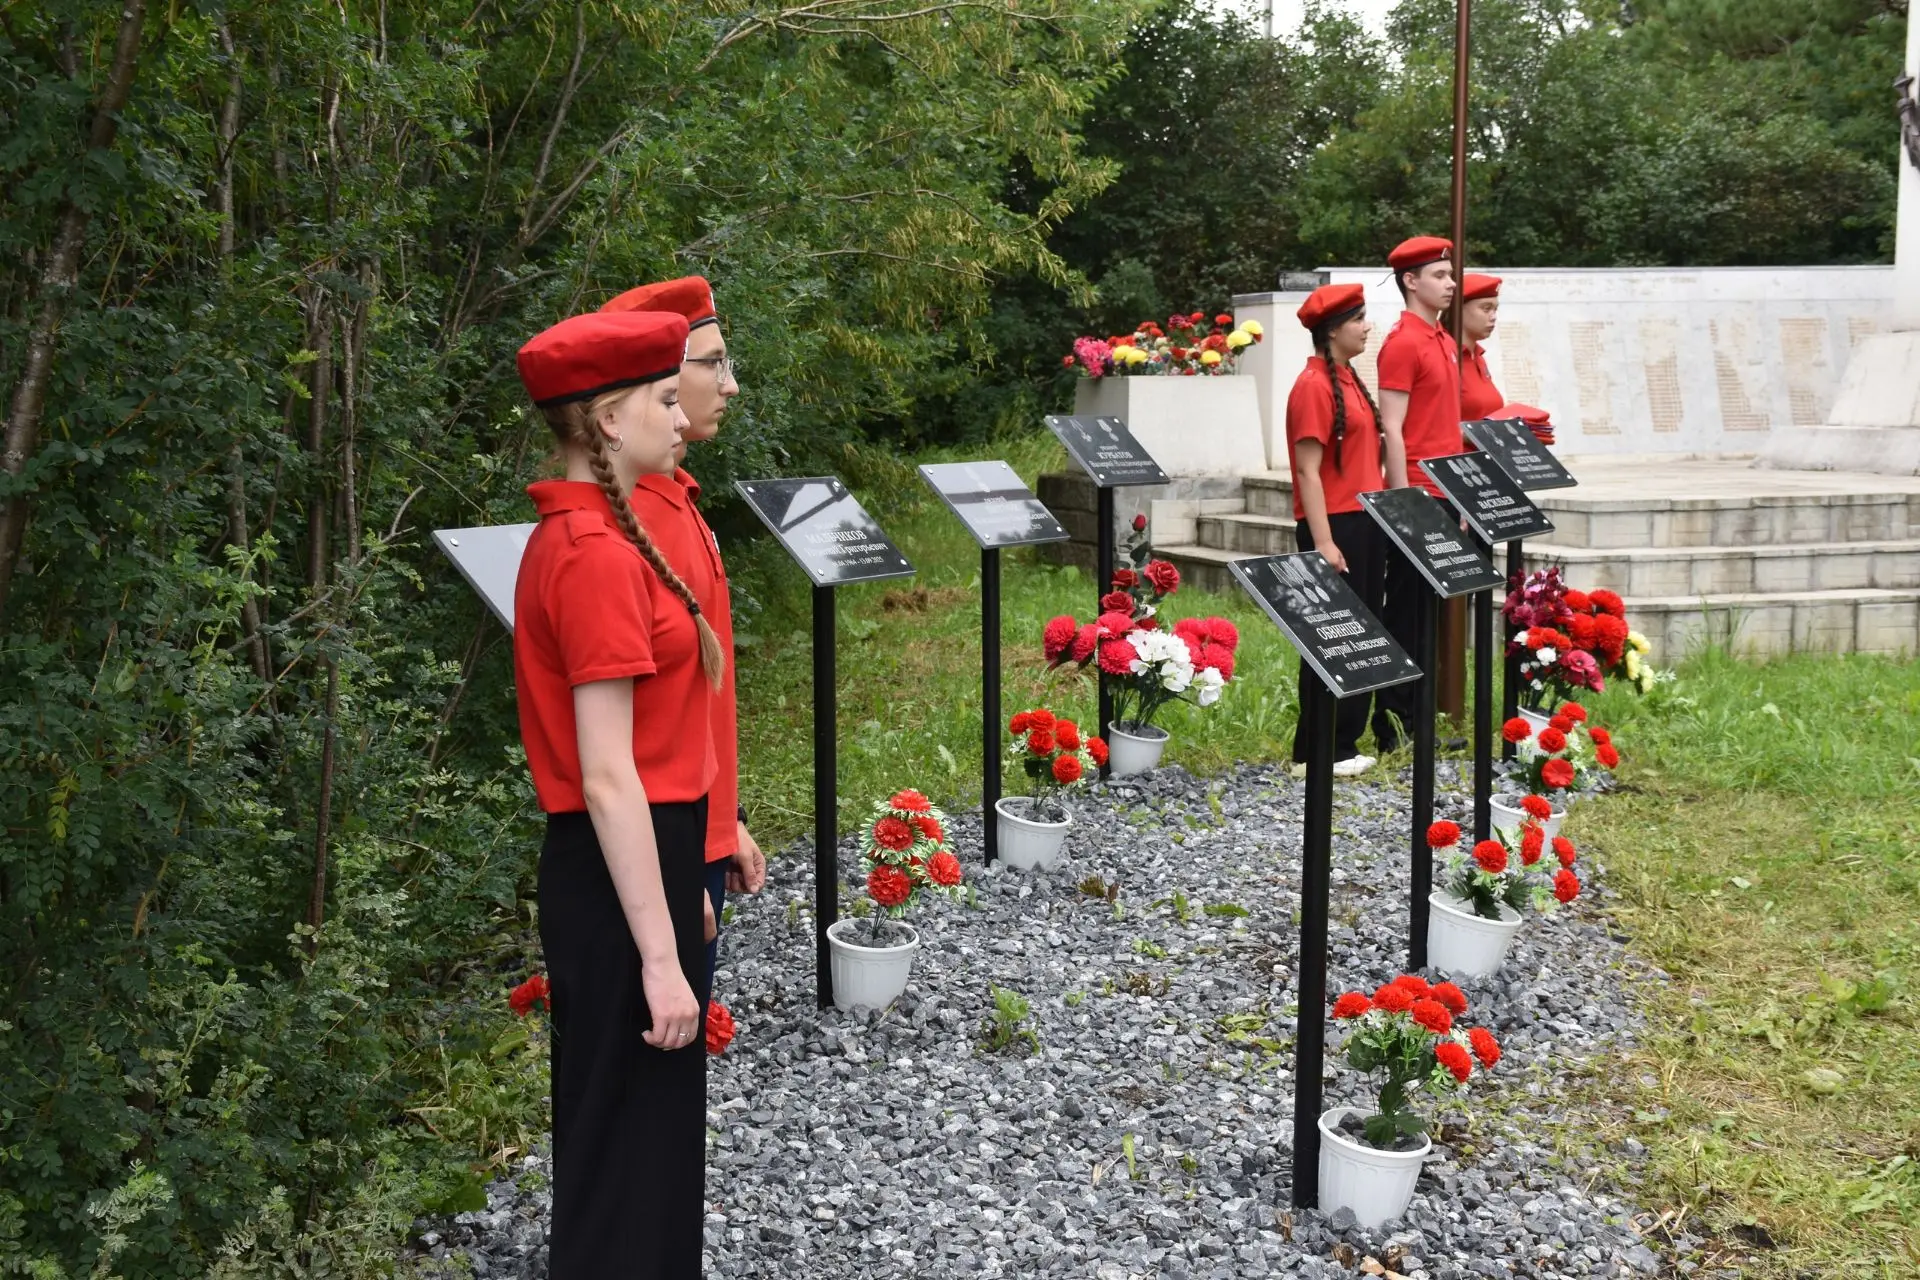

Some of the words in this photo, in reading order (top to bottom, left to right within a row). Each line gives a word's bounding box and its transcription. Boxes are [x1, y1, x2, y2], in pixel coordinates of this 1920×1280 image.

[1477, 496, 1515, 509] ВАСИЛЬЕВ
[805, 530, 868, 543] МАЛЬЧИКОВ
[839, 542, 889, 556] Григорьевич
[1425, 541, 1463, 555] ОБВИНЦЕВ
[1303, 606, 1332, 624] младший
[1330, 609, 1353, 621] сержант
[1316, 621, 1366, 640] ОБВИНЦЕВ
[1317, 641, 1354, 660] Дмитрий
[1348, 636, 1391, 652] Алексеевич
